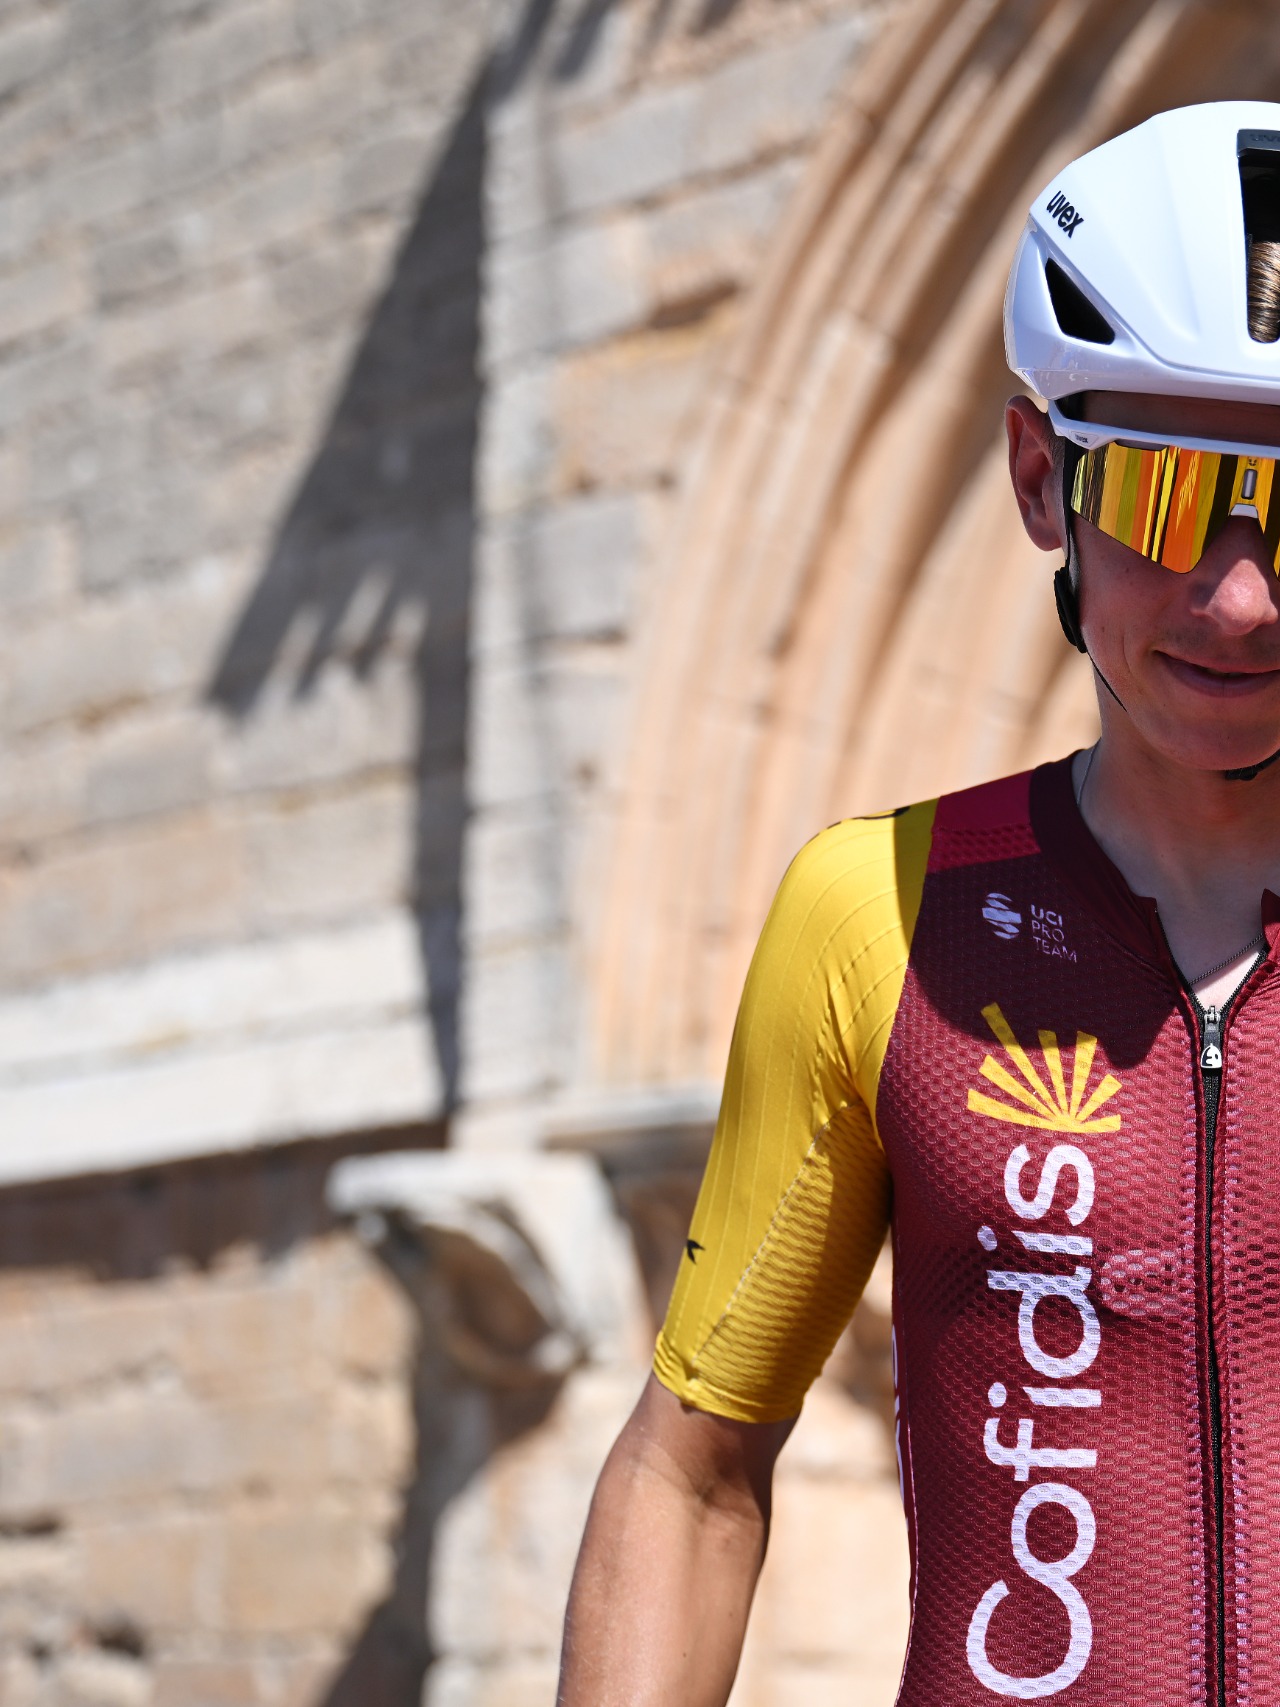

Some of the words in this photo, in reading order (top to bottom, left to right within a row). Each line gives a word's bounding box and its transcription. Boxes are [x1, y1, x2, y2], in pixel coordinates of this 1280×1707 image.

[1046, 190, 1085, 239] uvex
[1030, 904, 1063, 927] UCI
[1031, 919, 1065, 942] PRO
[1033, 935, 1077, 963] TEAM
[966, 1143, 1101, 1699] Cofidis
